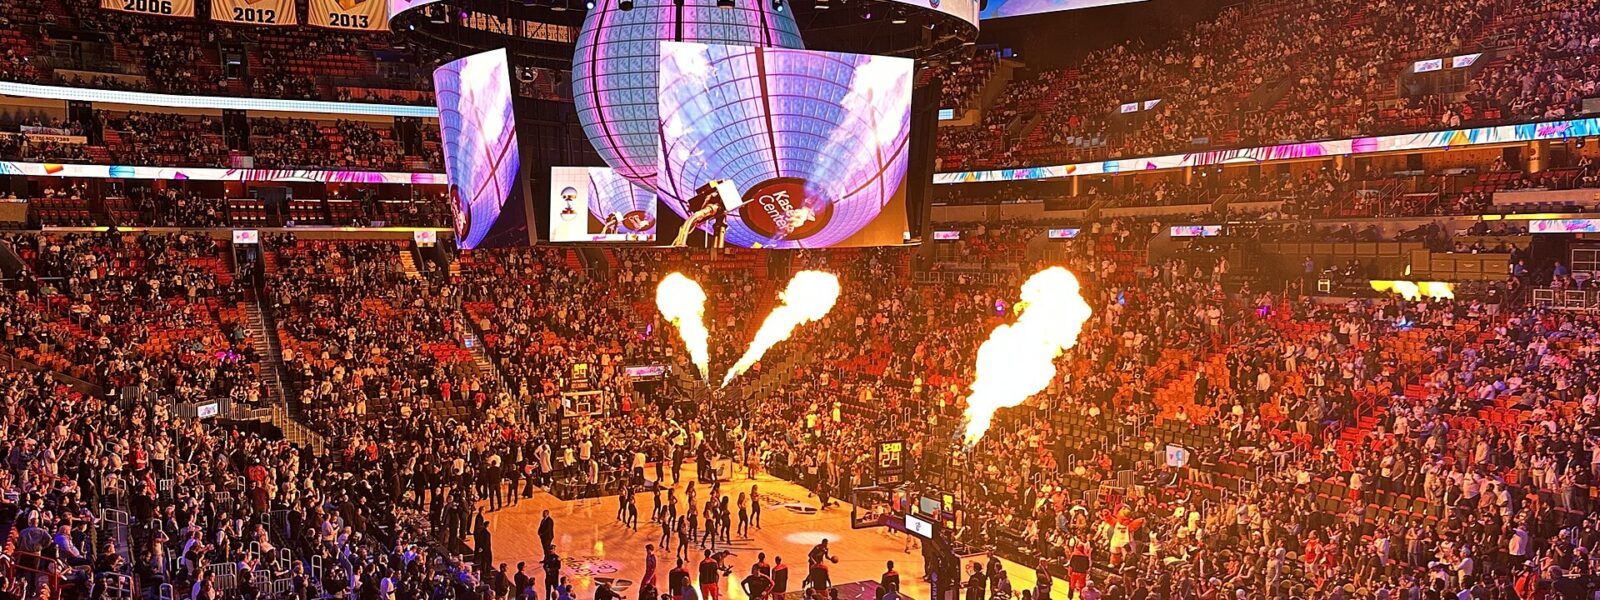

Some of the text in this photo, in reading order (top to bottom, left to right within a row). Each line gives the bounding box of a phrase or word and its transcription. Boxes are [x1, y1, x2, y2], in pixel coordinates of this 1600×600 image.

[123, 0, 172, 14] 2006
[233, 7, 276, 23] 2012
[329, 12, 369, 28] 2013
[758, 195, 793, 233] Cente
[882, 452, 900, 467] 24
